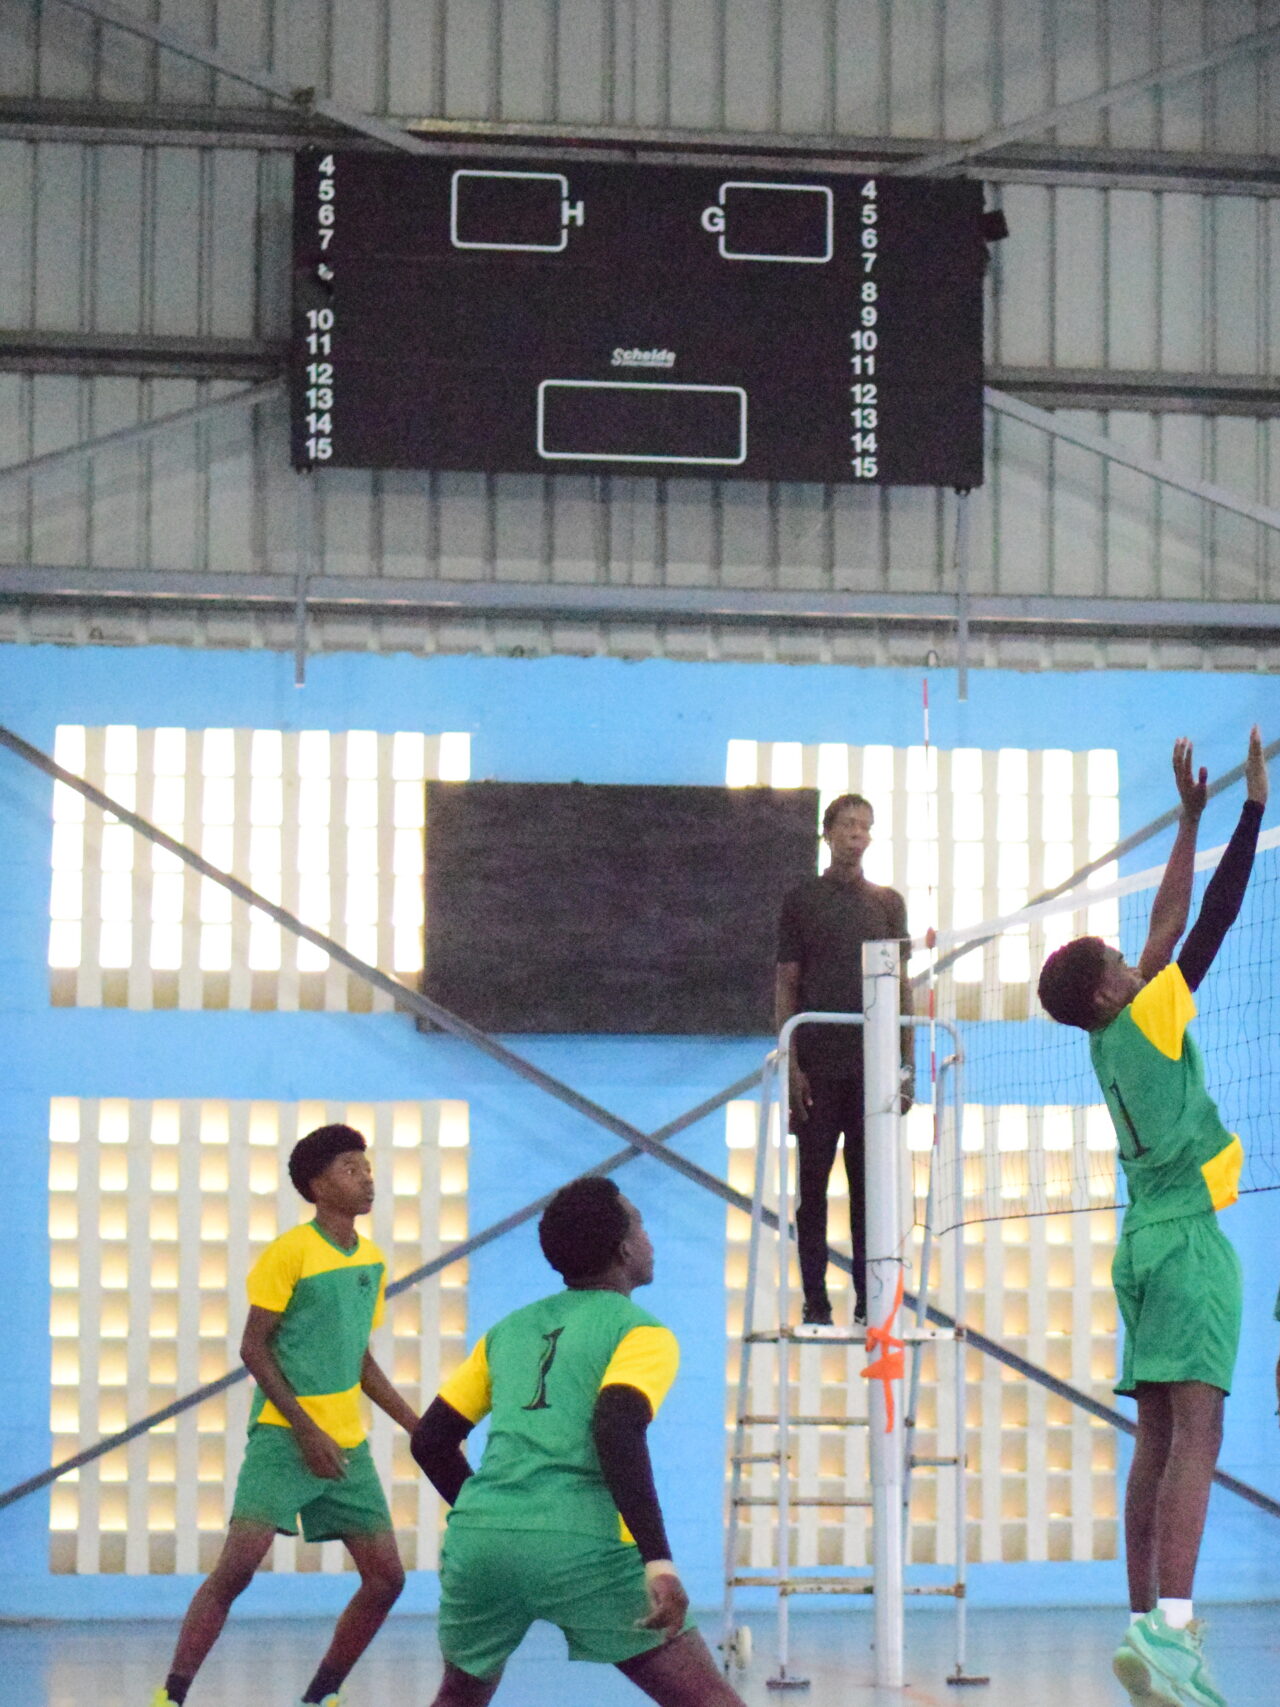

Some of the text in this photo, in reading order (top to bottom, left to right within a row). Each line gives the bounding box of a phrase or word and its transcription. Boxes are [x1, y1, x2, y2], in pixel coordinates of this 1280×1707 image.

[318, 154, 336, 177] 4
[318, 178, 336, 201] 5
[861, 179, 878, 200] 4
[318, 203, 336, 226] 6
[561, 199, 585, 227] H
[701, 206, 726, 233] G
[861, 203, 878, 225] 5
[318, 228, 335, 250] 7
[861, 227, 878, 250] 6
[861, 251, 878, 273] 7
[861, 281, 878, 303] 8
[306, 308, 335, 331] 10
[861, 305, 878, 327] 9
[306, 332, 332, 356] 11
[850, 329, 878, 352] 10
[306, 362, 334, 385] 12
[850, 354, 876, 376] 11
[305, 387, 334, 410] 13
[850, 383, 878, 405] 12
[305, 412, 333, 435] 14
[850, 407, 878, 430] 13
[304, 437, 333, 460] 15
[850, 431, 878, 454] 14
[850, 456, 879, 478] 15
